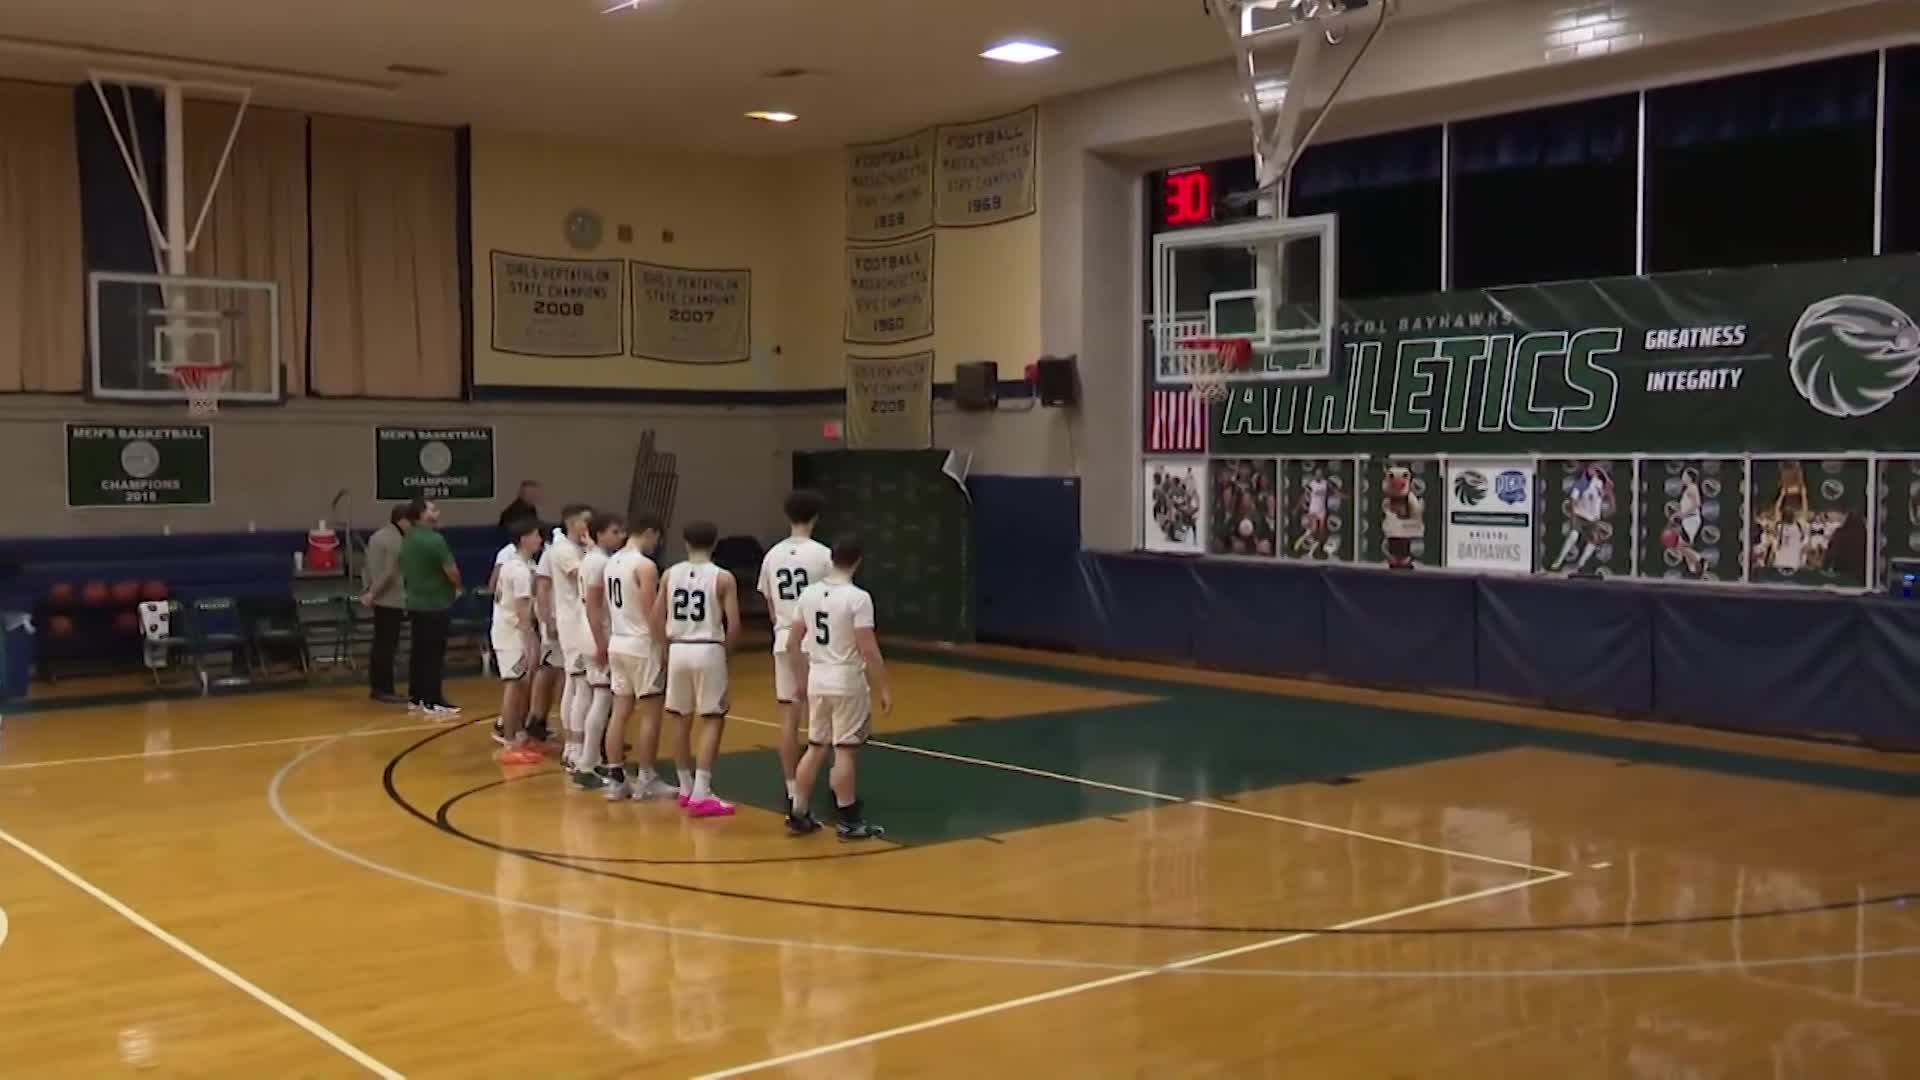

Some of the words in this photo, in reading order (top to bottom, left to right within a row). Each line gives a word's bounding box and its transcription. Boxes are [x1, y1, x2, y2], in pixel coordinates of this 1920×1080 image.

[1167, 170, 1209, 223] 30
[855, 250, 921, 272] FOOTBALL
[533, 301, 585, 317] 2008
[669, 309, 715, 323] 2007
[1644, 325, 1746, 350] GREATNESS
[1222, 328, 1623, 435] ATHLETICS
[1646, 368, 1743, 391] INTEGRITY
[118, 428, 203, 439] BASKETBALL
[418, 430, 489, 440] BASKETBALL
[101, 480, 181, 490] CHAMPIONS
[1457, 542, 1521, 561] BAYHAWKS
[608, 577, 623, 609] 10
[776, 568, 809, 600] 22
[673, 588, 706, 622] 23
[815, 611, 830, 645] 5
